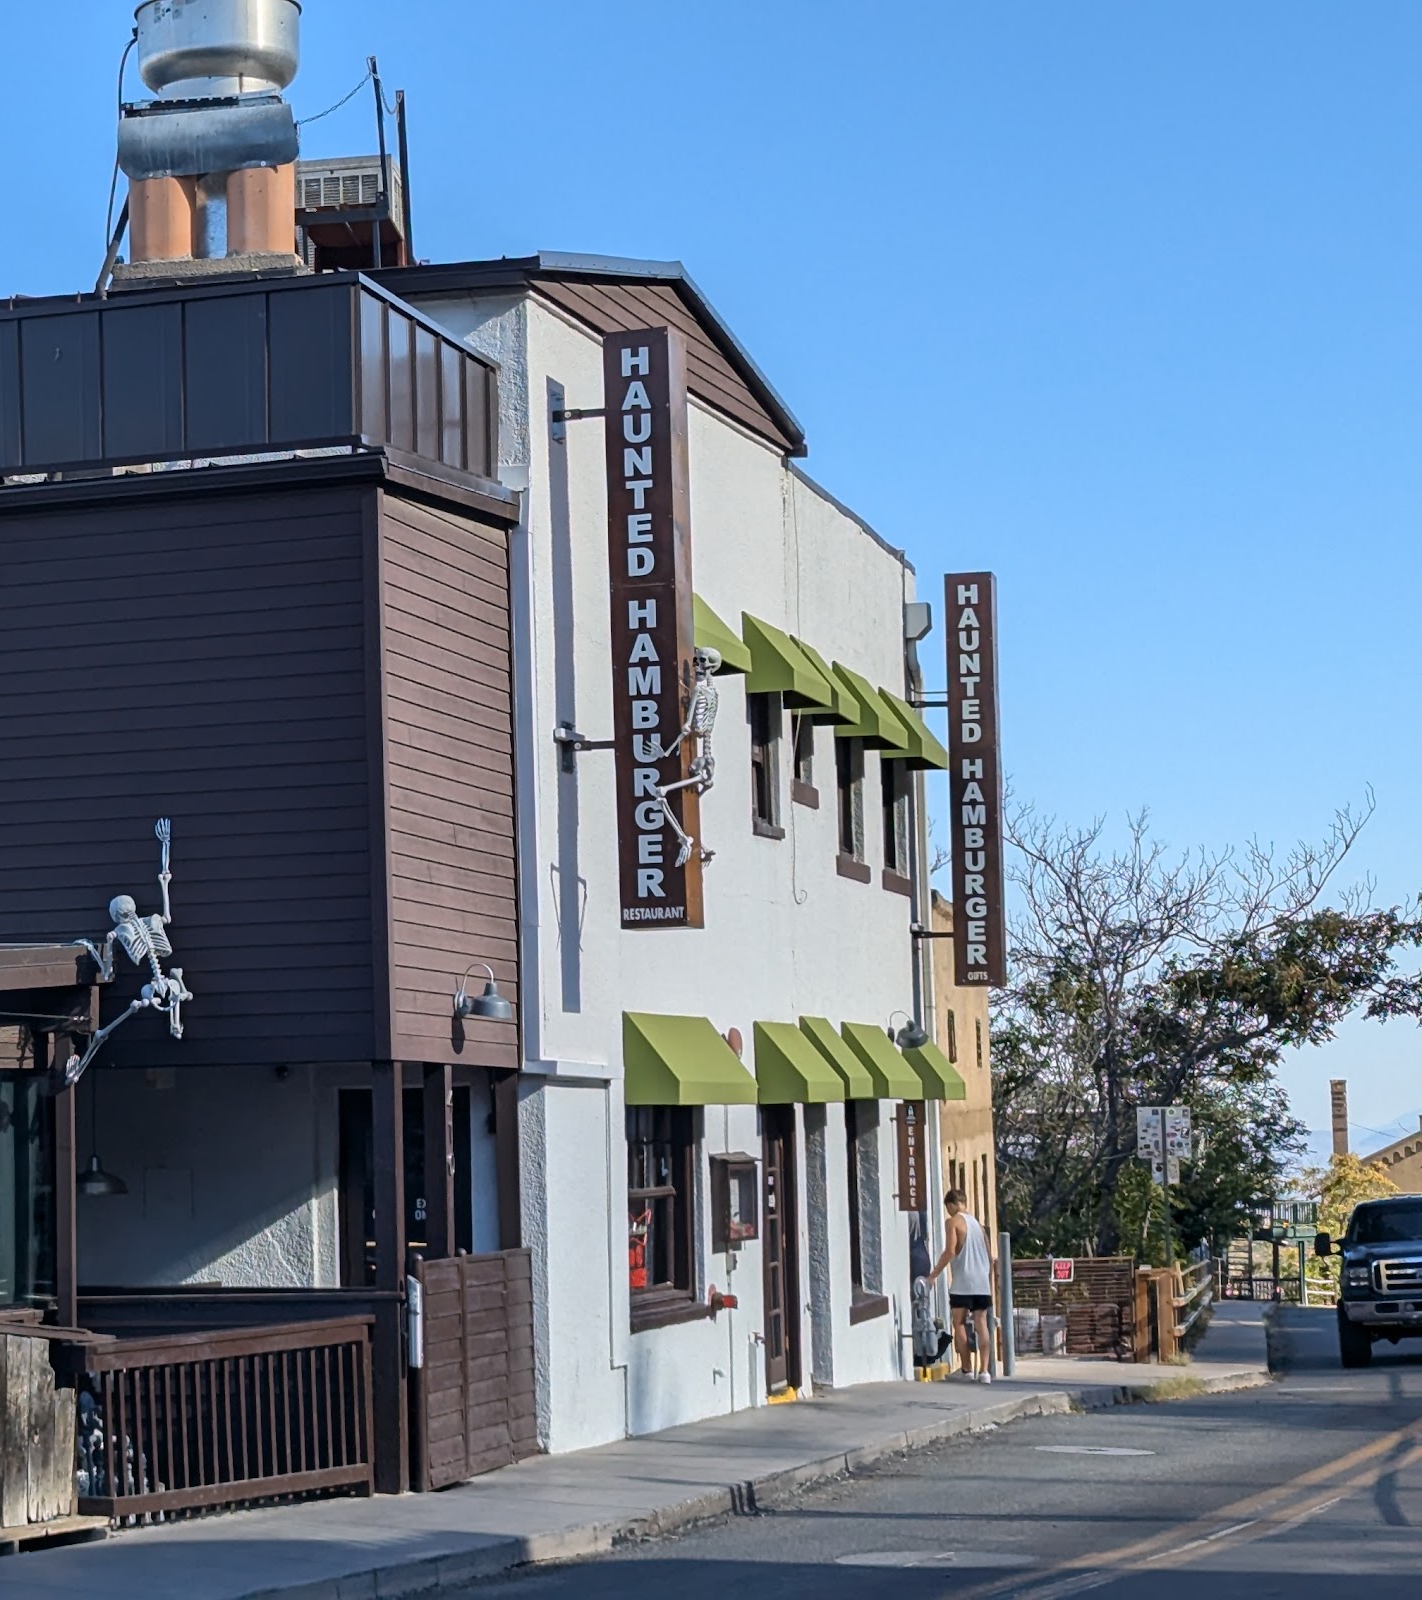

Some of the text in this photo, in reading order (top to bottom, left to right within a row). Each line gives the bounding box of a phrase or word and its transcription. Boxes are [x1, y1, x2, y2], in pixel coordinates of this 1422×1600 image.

[621, 346, 666, 898] HAUNTED HAMBURGER
[957, 584, 988, 965] HAUNTED HAMBURGER
[623, 906, 684, 920] RESTAURANT
[967, 971, 988, 980] GIFTS
[907, 1126, 916, 1207] ENTRANCE
